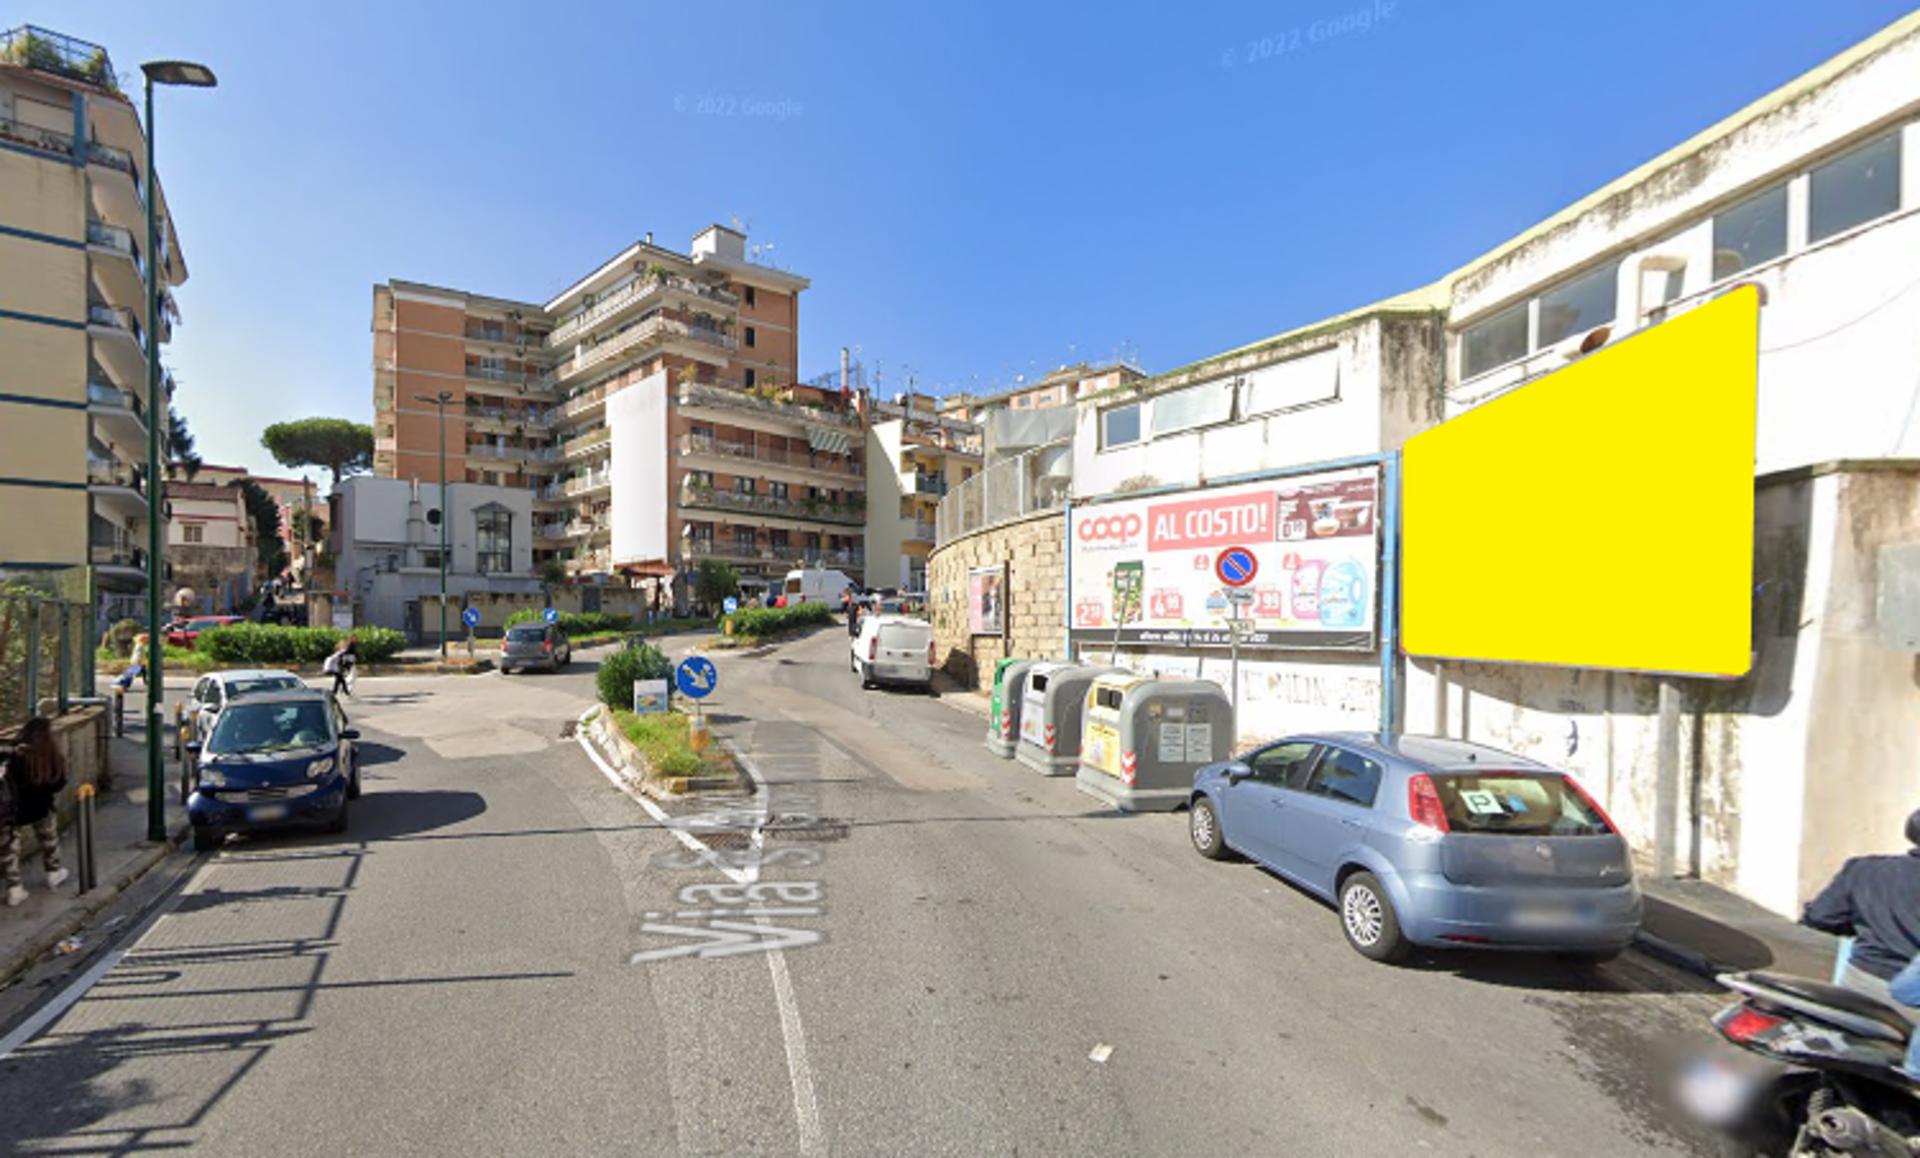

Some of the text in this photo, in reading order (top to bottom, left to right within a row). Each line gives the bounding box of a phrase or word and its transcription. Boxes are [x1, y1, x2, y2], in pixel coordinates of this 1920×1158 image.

[1078, 513, 1142, 542] coop
[1153, 513, 1182, 542] AL
[1184, 502, 1268, 539] COSTO!
